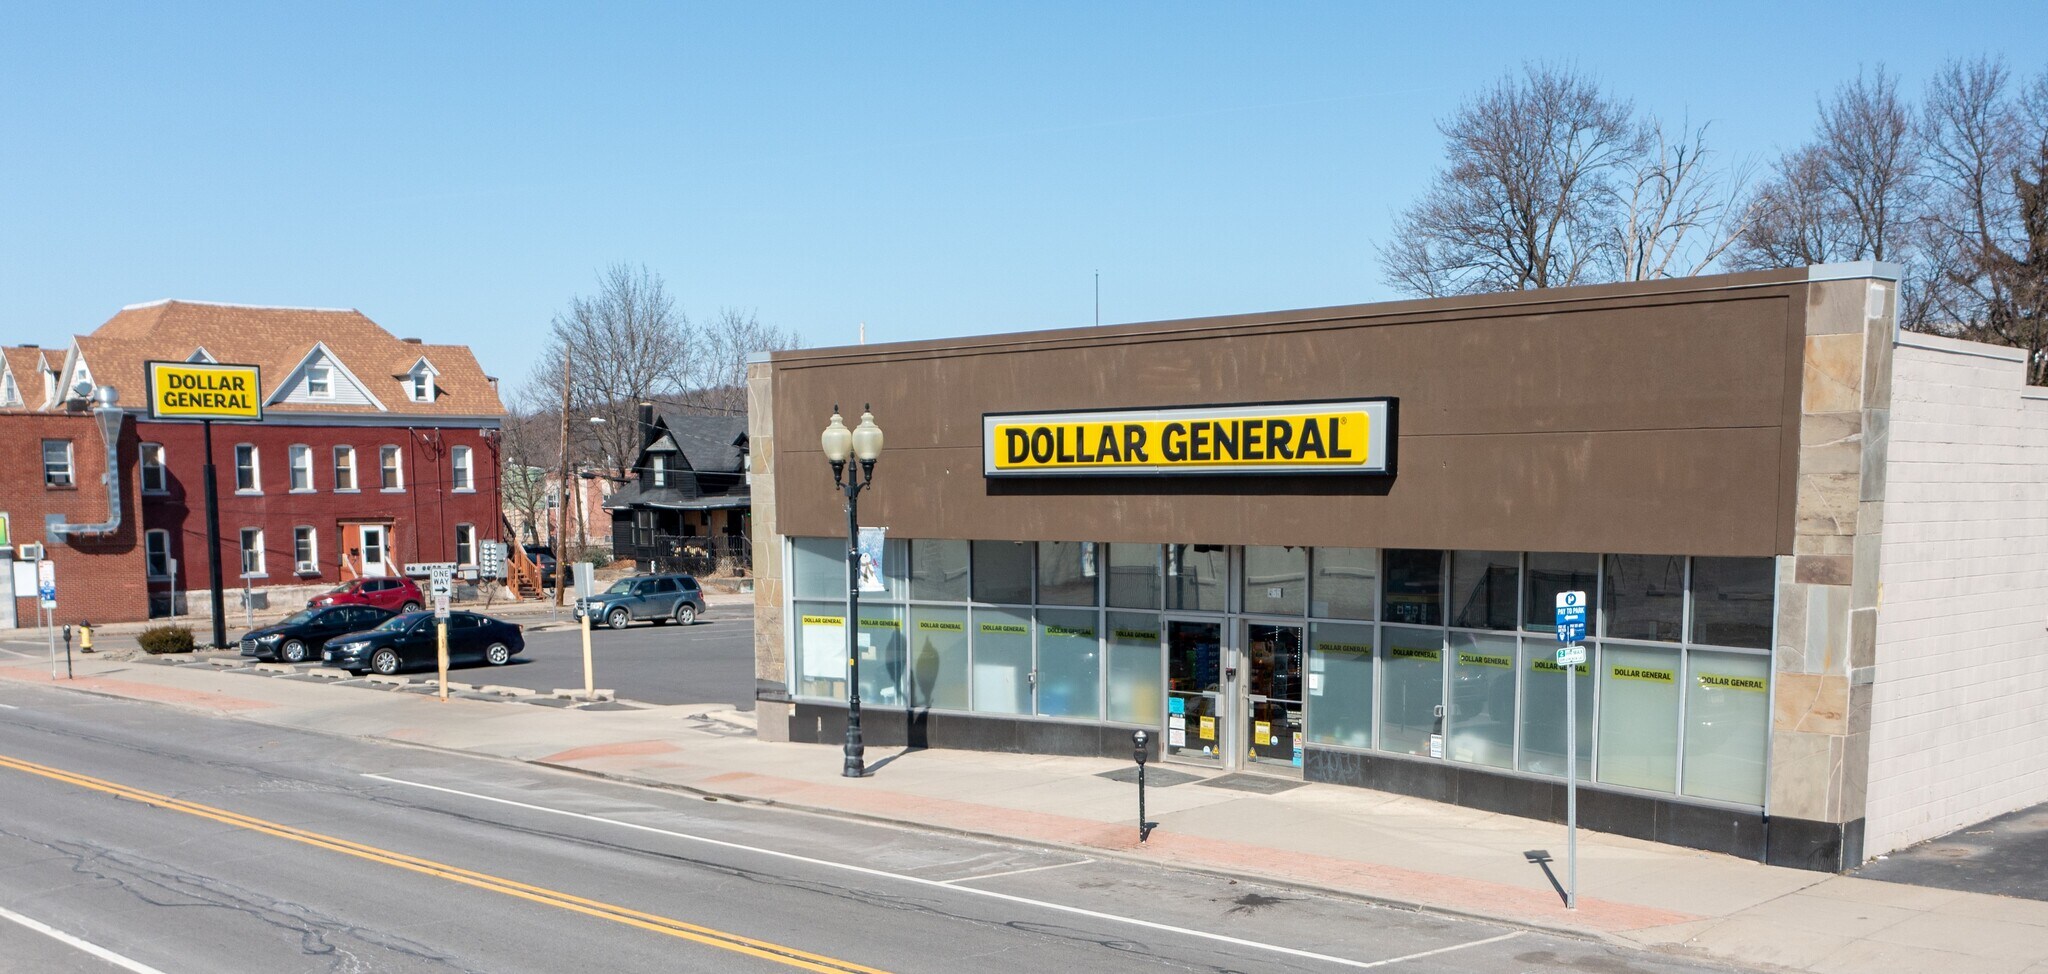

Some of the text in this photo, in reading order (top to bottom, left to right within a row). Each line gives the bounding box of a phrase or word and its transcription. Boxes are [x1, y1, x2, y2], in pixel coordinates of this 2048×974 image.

[167, 374, 245, 391] DOLLAR
[164, 391, 252, 409] GENERAL
[1006, 417, 1352, 464] DOLLAR GENERAL
[1002, 625, 1026, 633] GENERAL
[1115, 630, 1156, 639] DOLLAR GENERAL
[1319, 643, 1368, 653] DOLLAR GENERAL
[1392, 648, 1438, 659] DOLLAR GENERAL
[1461, 654, 1509, 666] DOLLAR GENERAL
[1534, 661, 1587, 673] DOLLAR GERAL
[1614, 668, 1671, 680] DOLLAR GENERAL
[1701, 676, 1763, 689] DOLLAR GENERAL
